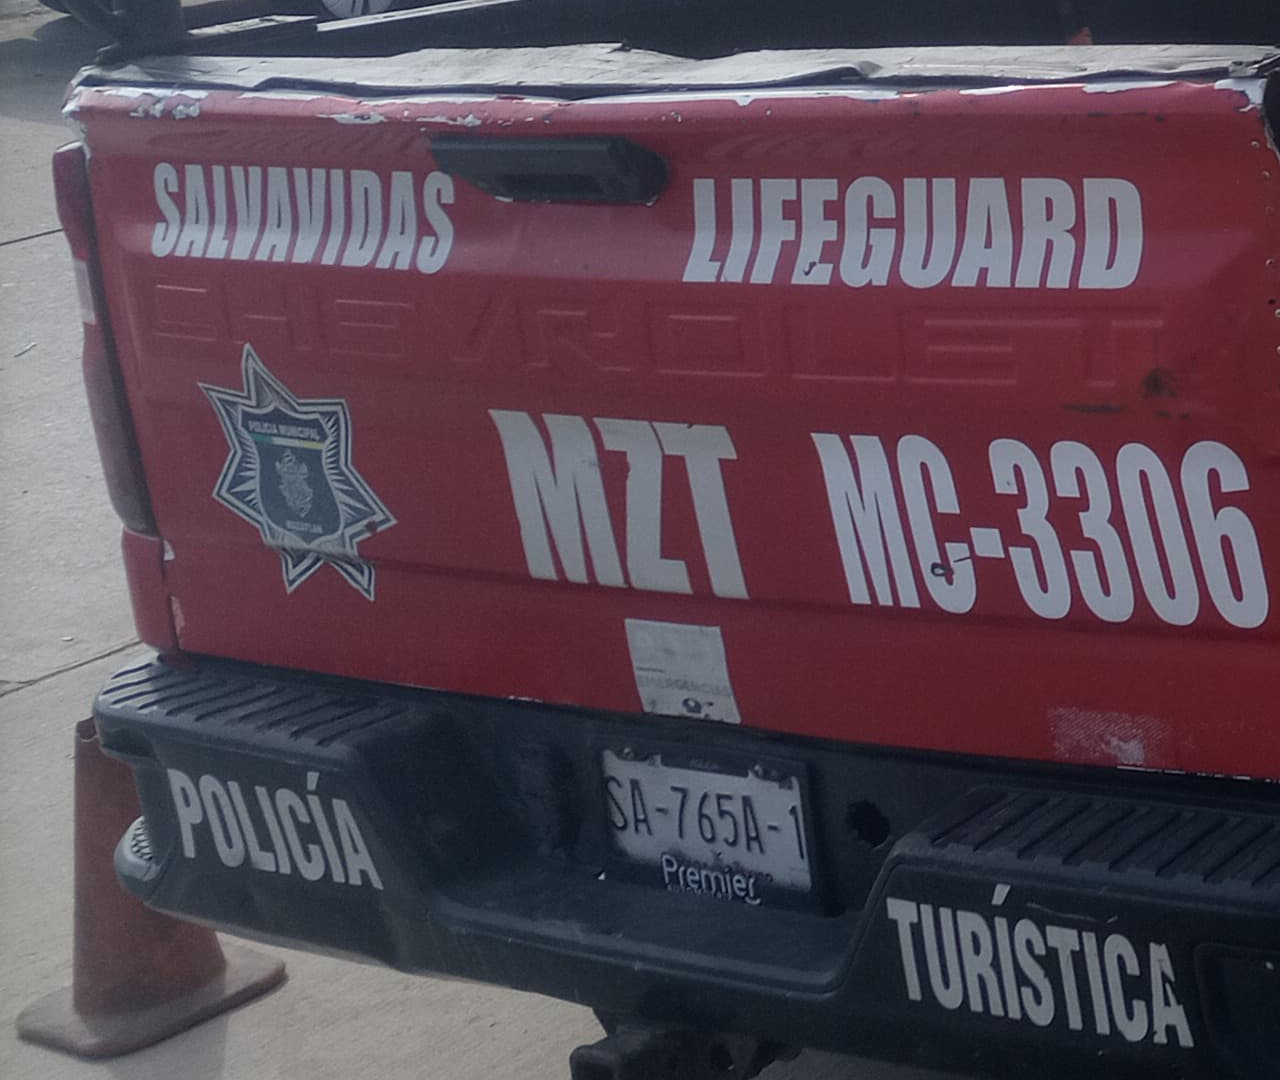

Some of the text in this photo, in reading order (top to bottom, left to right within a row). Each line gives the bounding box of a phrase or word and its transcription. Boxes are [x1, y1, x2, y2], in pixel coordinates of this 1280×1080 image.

[152, 162, 454, 274] SALVAVIDAS
[682, 176, 1144, 290] LIFEGUARD
[488, 409, 1270, 629] MZT MC-3306
[167, 768, 1194, 1048] POLICÍA TURÍSTICA
[661, 854, 756, 898] Premier
